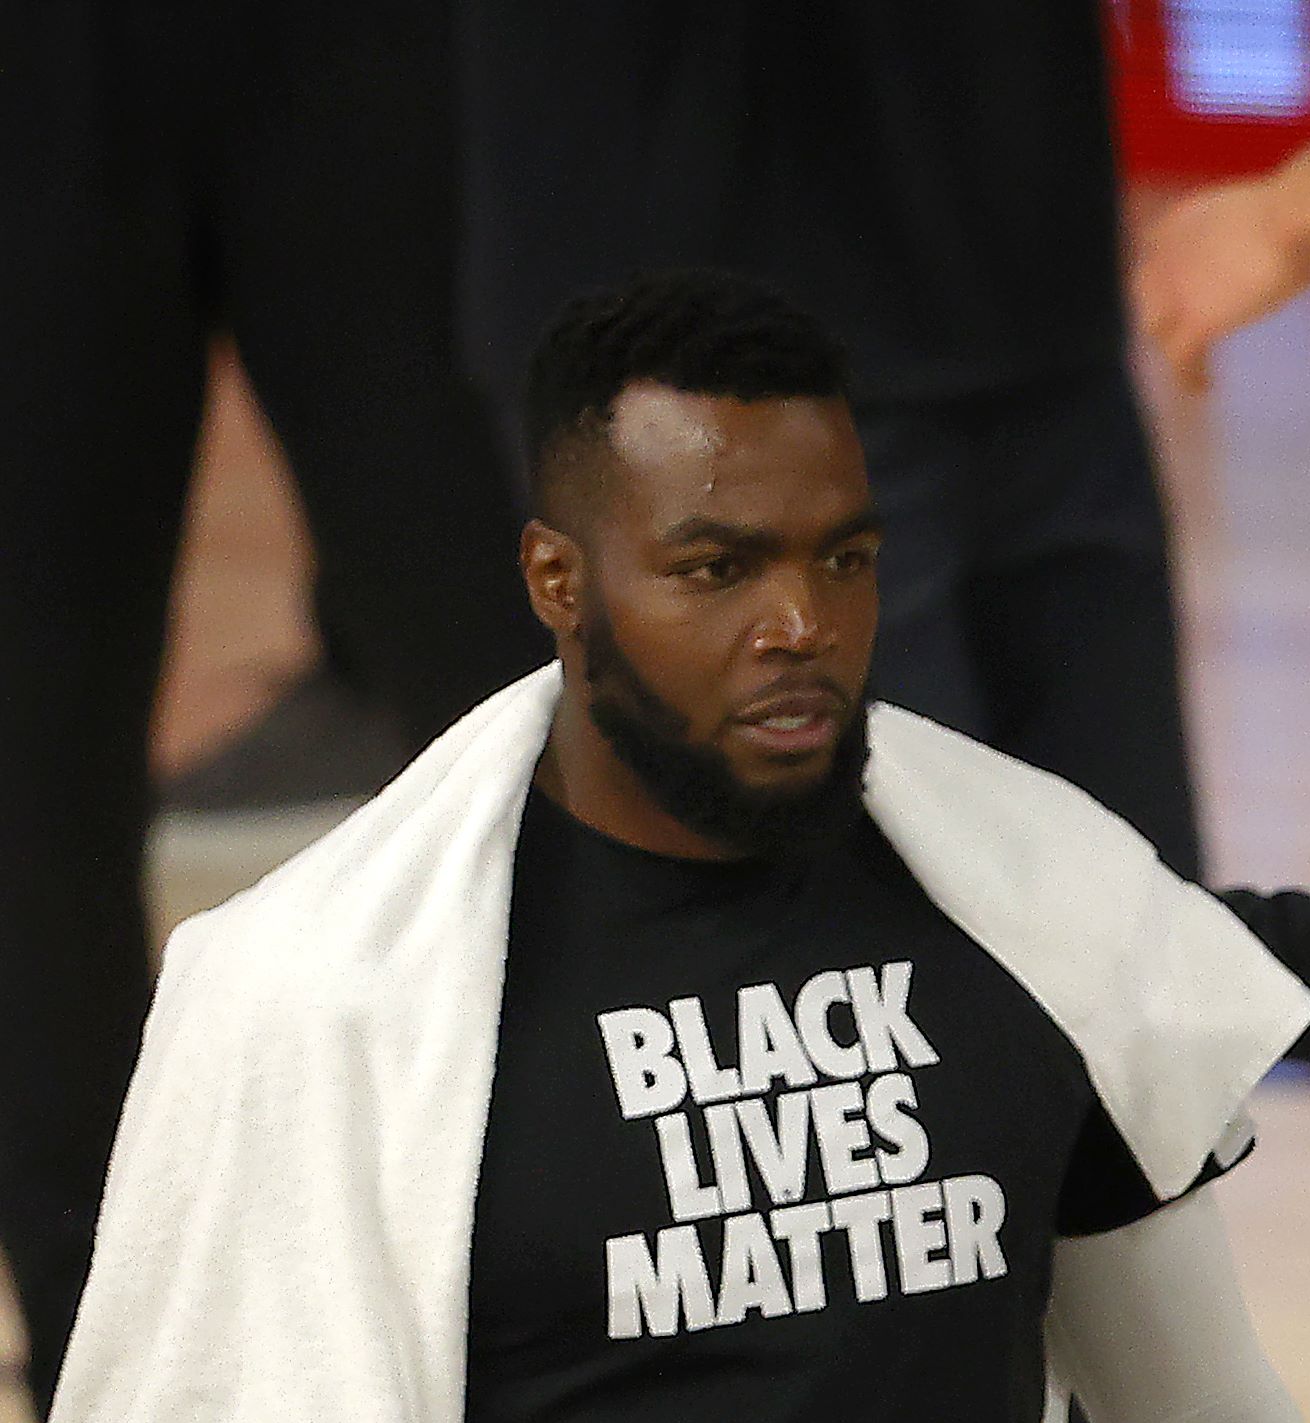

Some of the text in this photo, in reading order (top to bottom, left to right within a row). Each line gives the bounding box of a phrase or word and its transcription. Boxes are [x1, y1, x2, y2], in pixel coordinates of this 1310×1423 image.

[597, 961, 941, 1119] BLACK
[655, 1072, 930, 1222] LIVES
[605, 1173, 1008, 1340] MATTER
